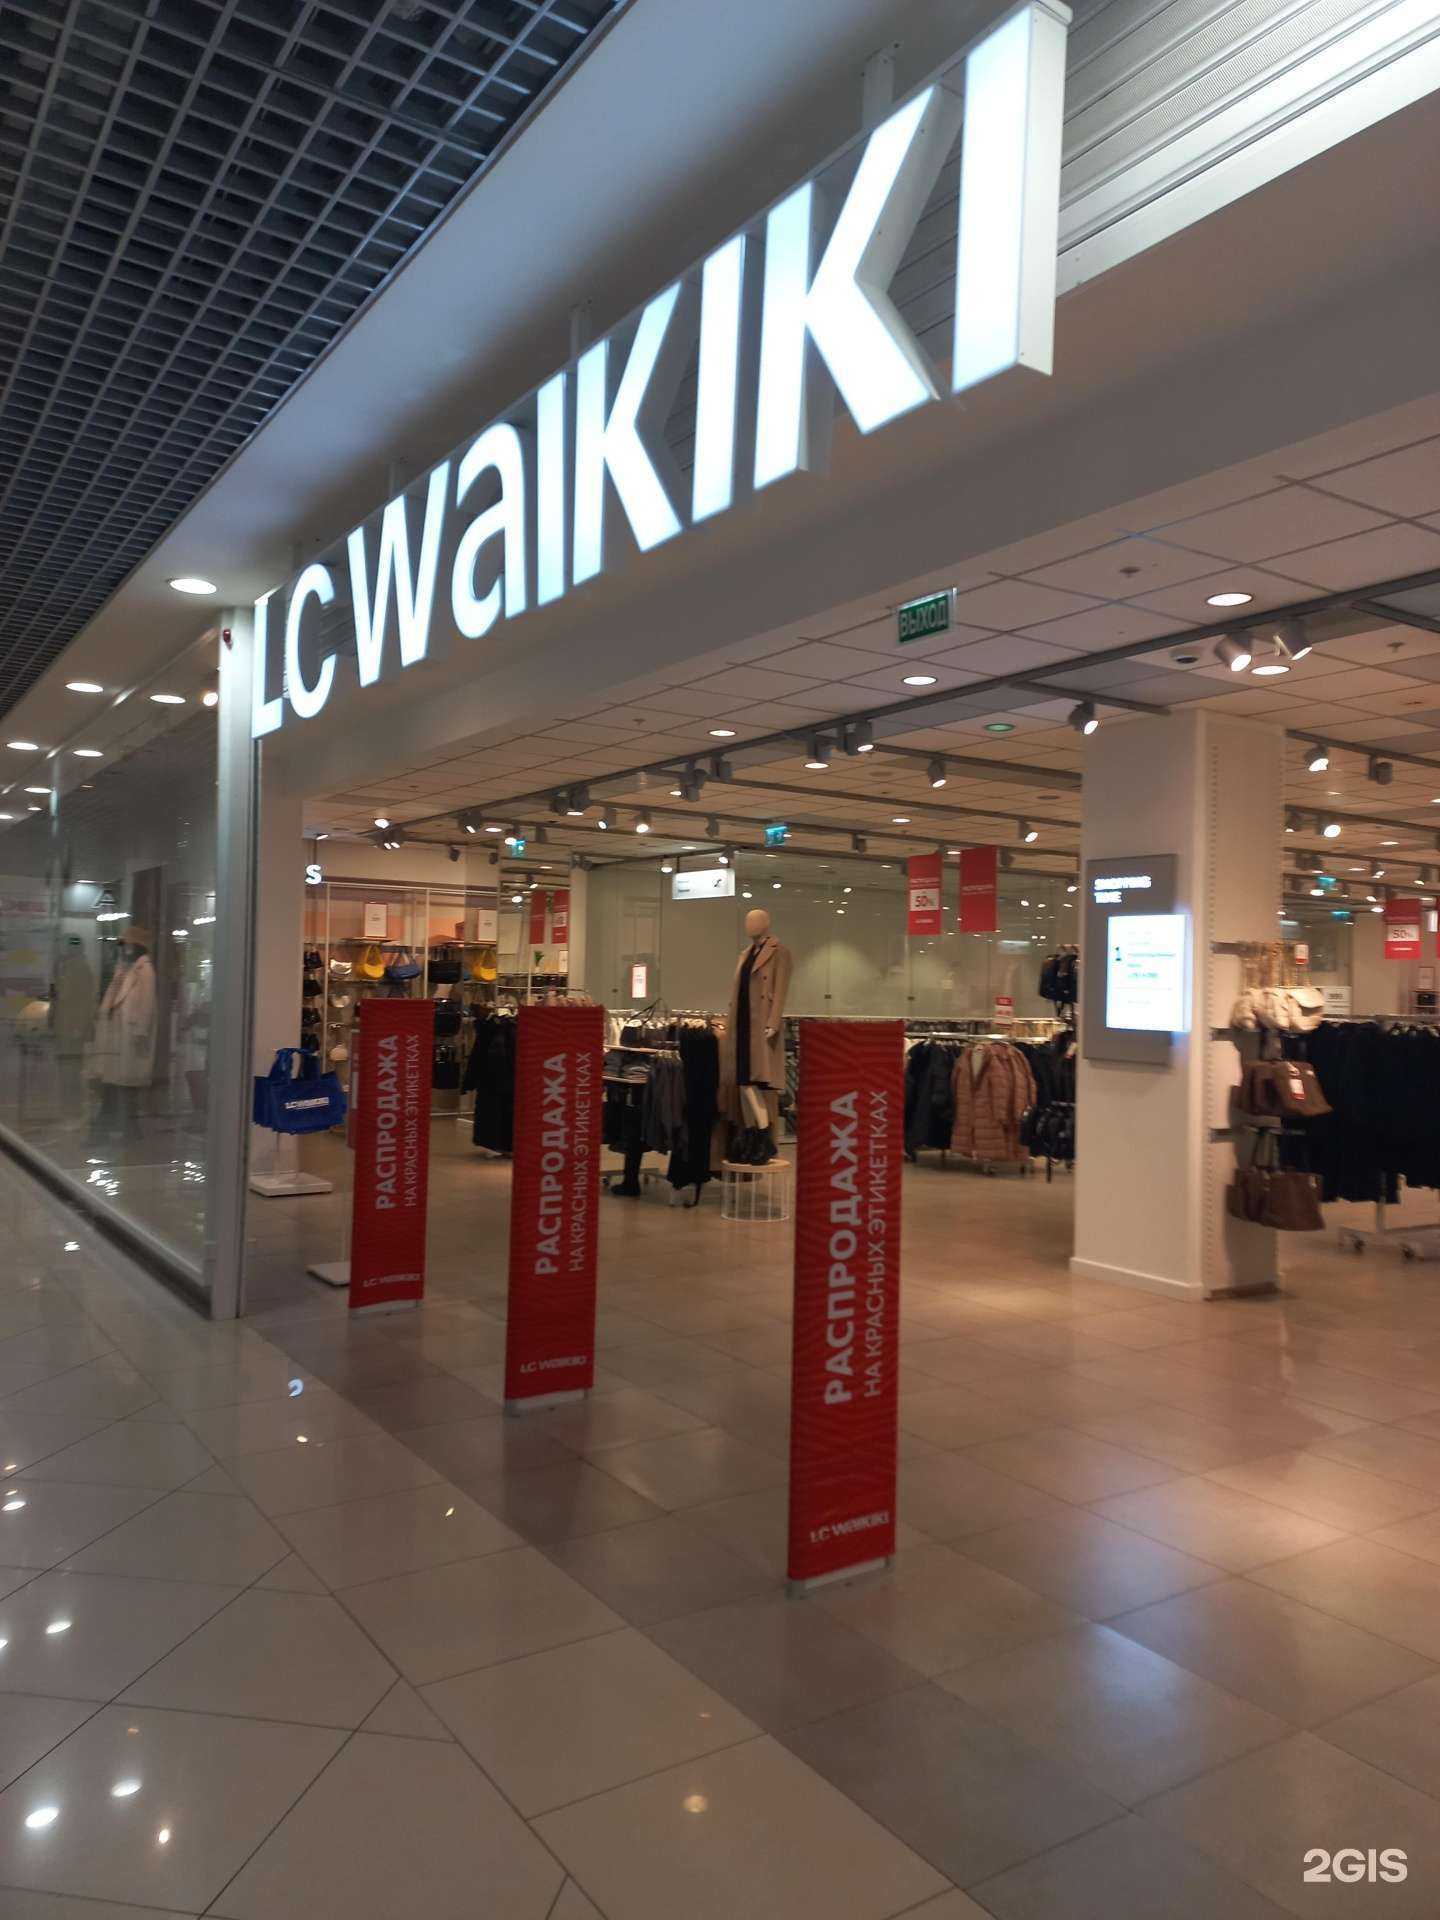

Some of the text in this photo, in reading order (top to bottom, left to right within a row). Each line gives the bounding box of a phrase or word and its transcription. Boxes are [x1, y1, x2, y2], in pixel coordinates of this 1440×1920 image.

[252, 563, 337, 738] LC
[901, 600, 946, 637] ВЫХОД
[375, 1034, 400, 1210] РАСПРОДАЖА
[404, 1035, 419, 1207] НА КРАСНЫХ ЭТИКЕТКАХ
[534, 1053, 569, 1275] РАСПРОДАЖА
[569, 1052, 591, 1272] НА КРАСНЫХ ЭТИКЕТКАХ
[824, 1091, 863, 1404] РАСПРОДАЖА
[864, 1091, 888, 1397] НА КРАСНЫХ ЭТИКЕТКАХ
